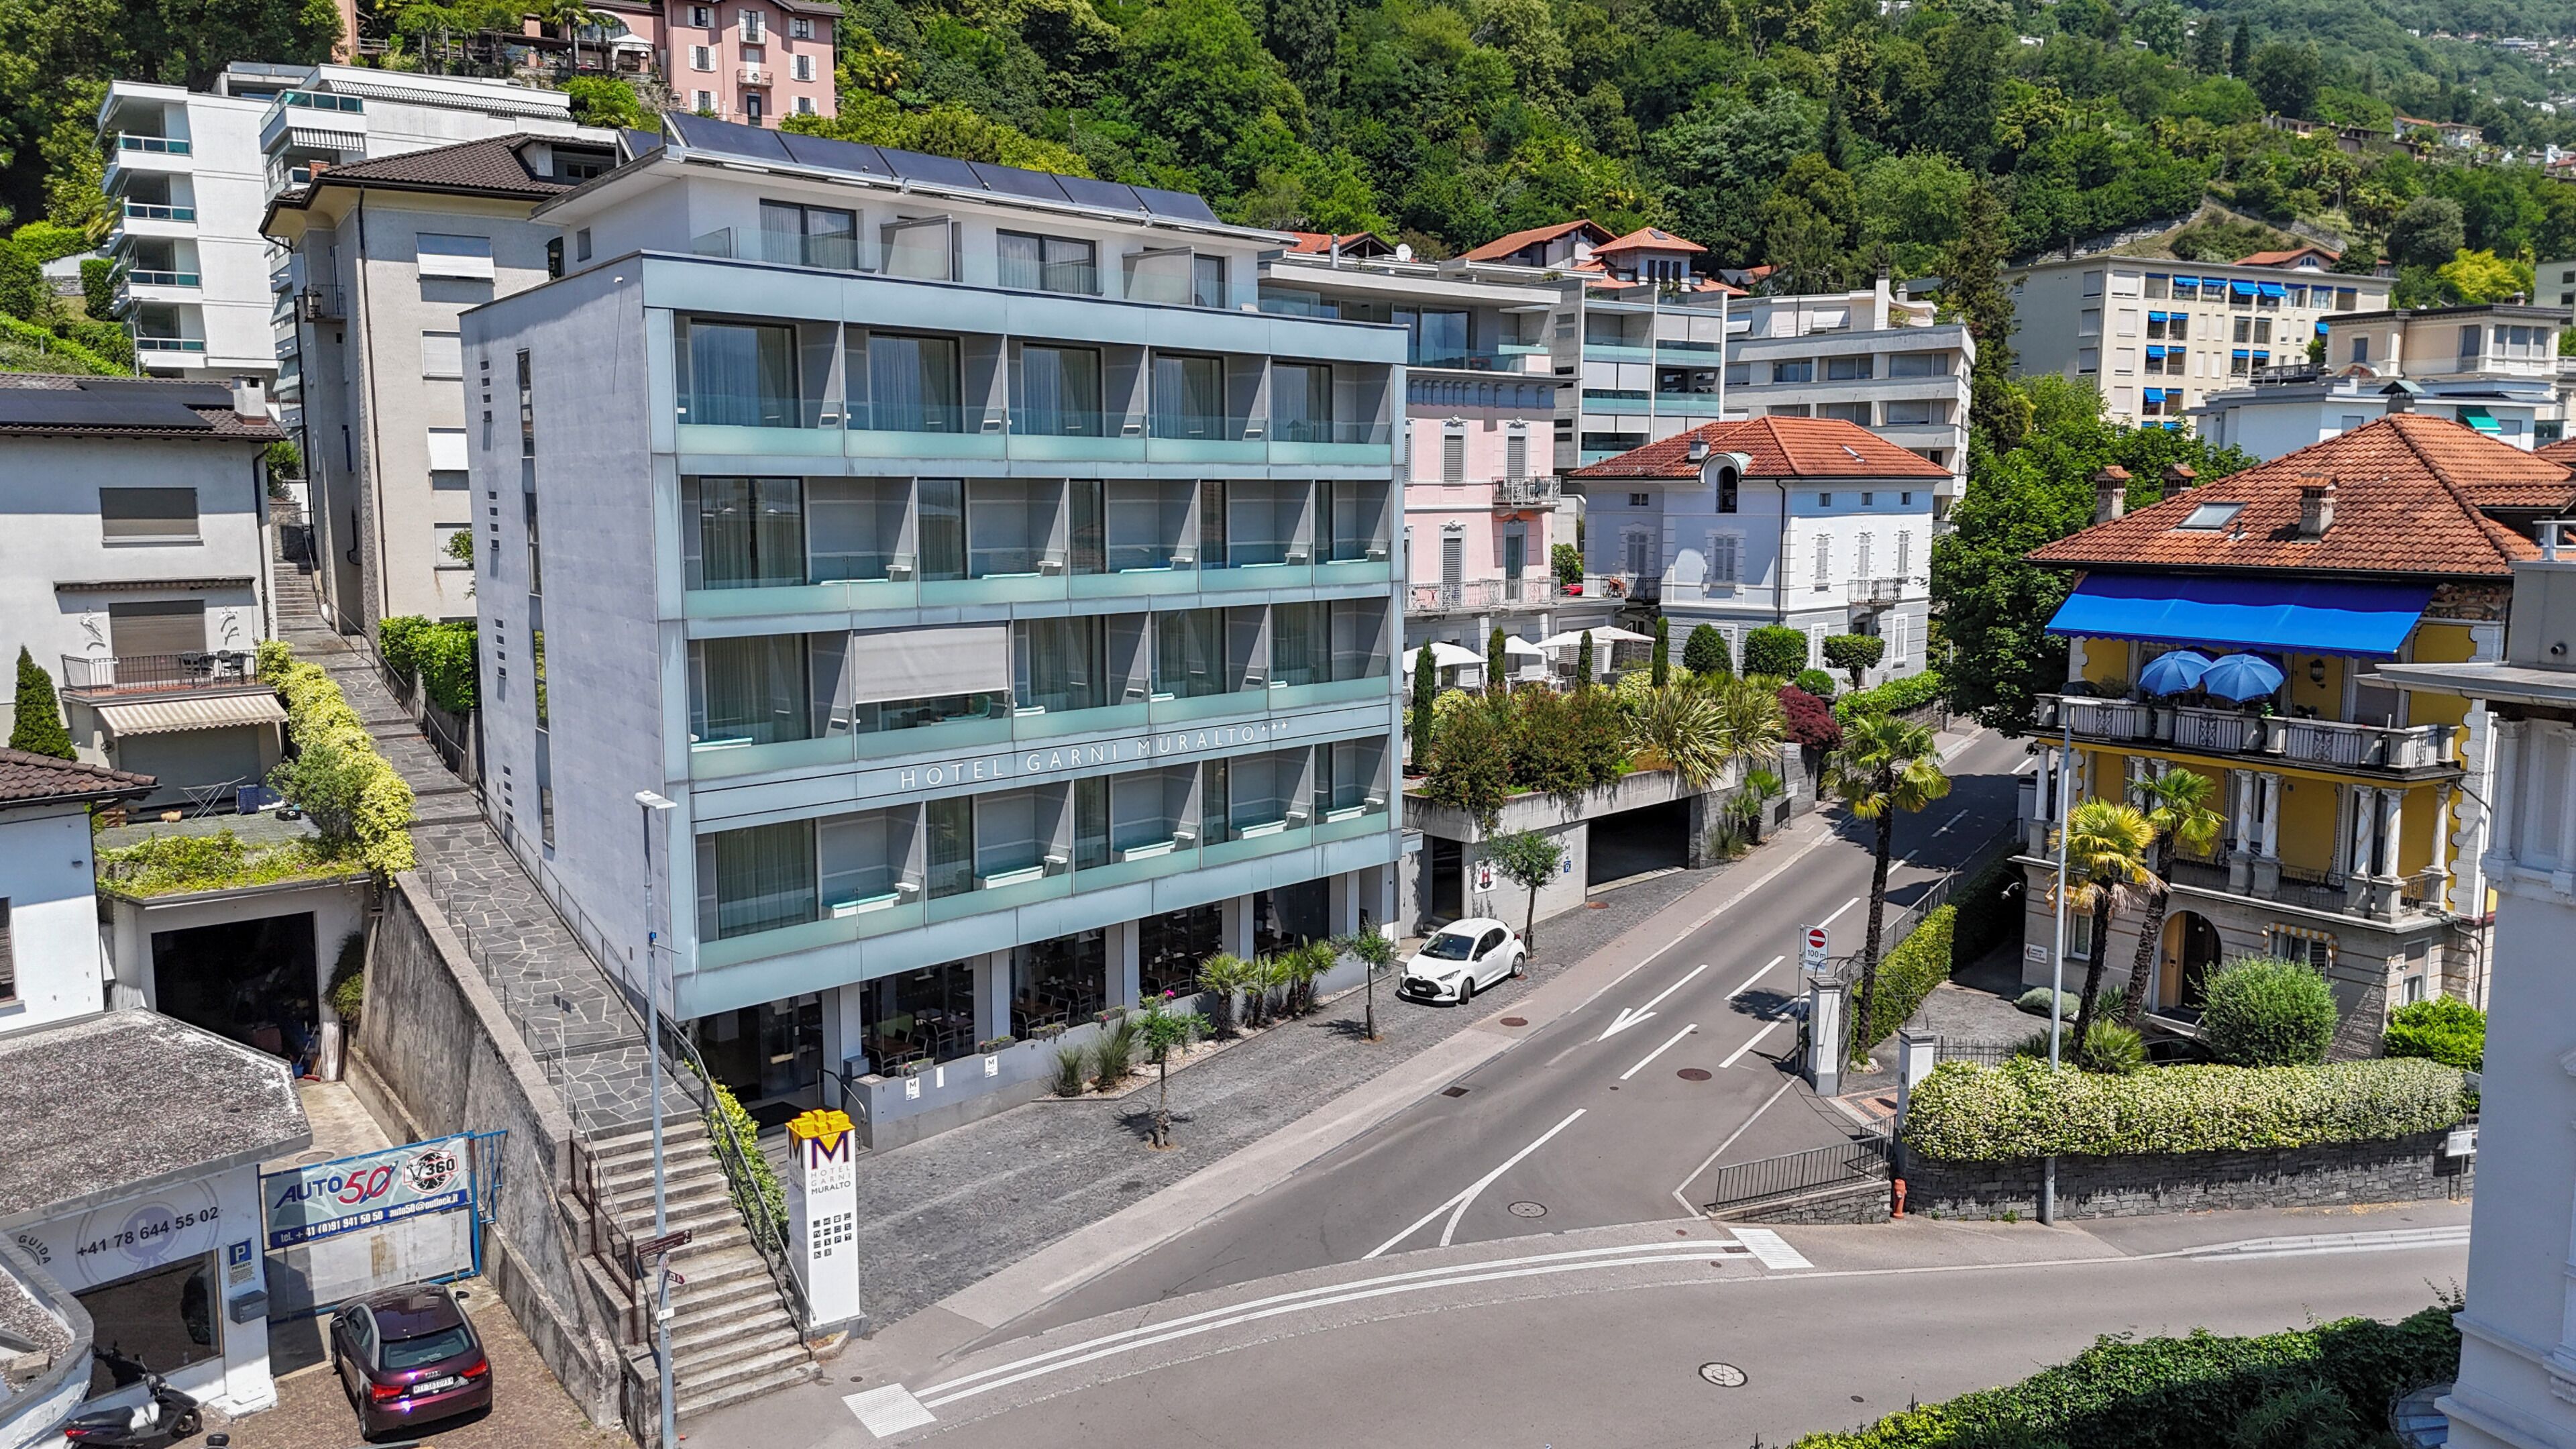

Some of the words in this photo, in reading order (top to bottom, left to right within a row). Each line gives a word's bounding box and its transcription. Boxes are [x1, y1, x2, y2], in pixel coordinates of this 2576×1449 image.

[901, 759, 1003, 789] HOTEL
[1026, 743, 1117, 771] GARNI
[1138, 726, 1254, 757] MURALTO
[1807, 949, 1819, 958] 100
[811, 1131, 849, 1170] M
[426, 1159, 455, 1176] 360
[811, 1165, 851, 1179] HOTEL
[811, 1173, 851, 1187] GARNI
[811, 1181, 851, 1195] MURALTO
[77, 1238, 107, 1256] +41
[114, 1231, 134, 1247] 78
[140, 1220, 170, 1240] 644
[175, 1213, 195, 1230] 55
[200, 1206, 218, 1223] 02
[280, 1232, 293, 1242] tel.
[318, 1221, 341, 1234] (0)91
[343, 1216, 358, 1228] 941
[360, 1213, 371, 1224] 50
[372, 1210, 383, 1222] 50
[18, 1234, 52, 1265] GUIDA
[235, 1245, 246, 1261] P
